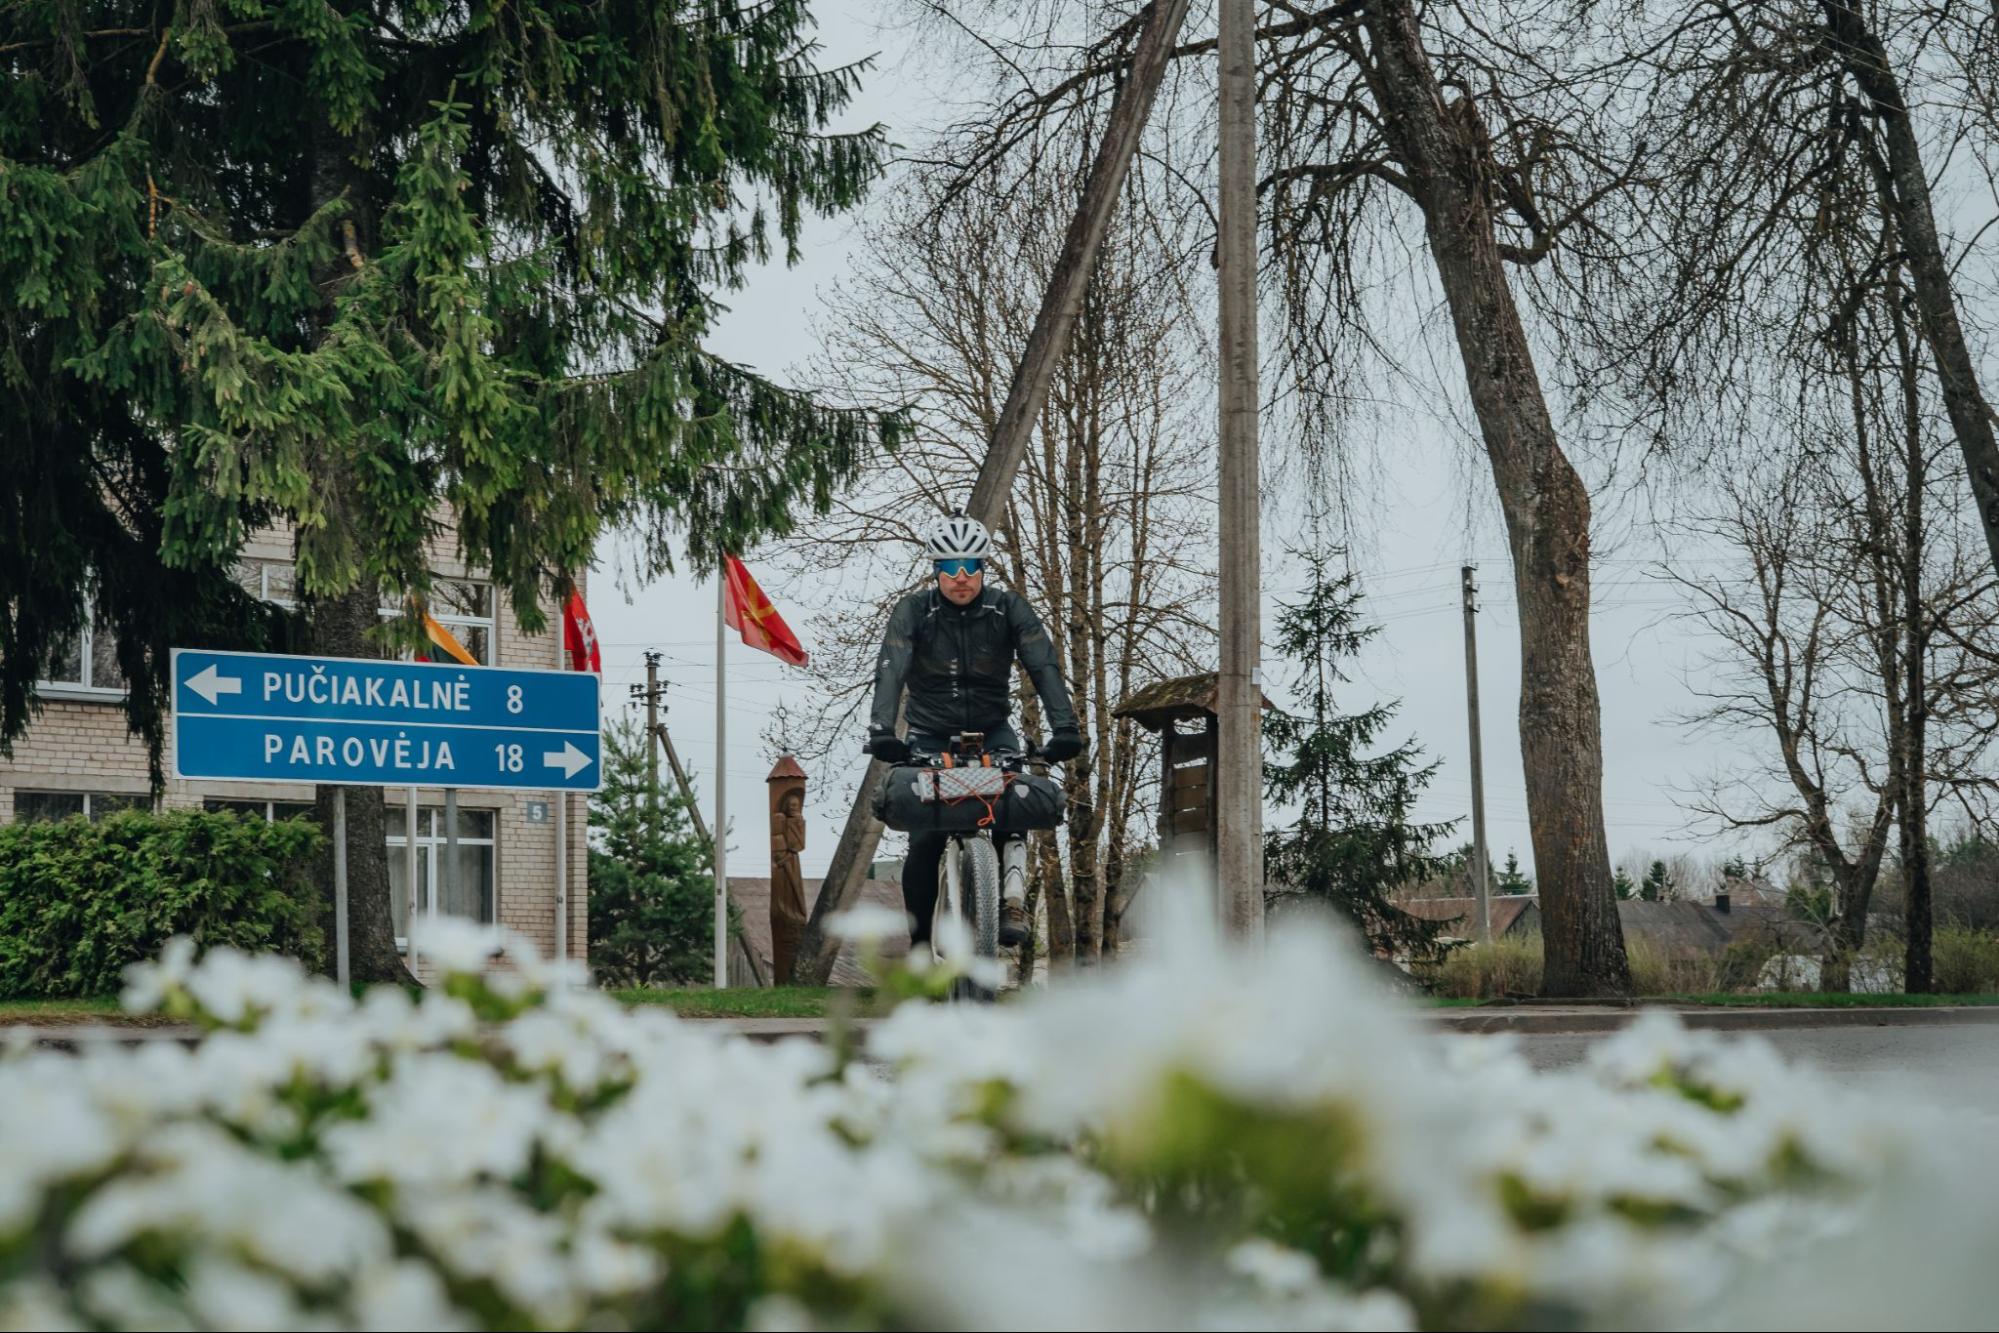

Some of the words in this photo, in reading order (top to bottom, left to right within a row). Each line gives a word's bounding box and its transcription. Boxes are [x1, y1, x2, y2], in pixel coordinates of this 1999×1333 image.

[263, 665, 471, 711] PUČIAKALNĖ
[507, 684, 523, 714] 8
[264, 731, 455, 770] PAROVĖJA
[495, 744, 524, 773] 18
[532, 805, 543, 820] 5
